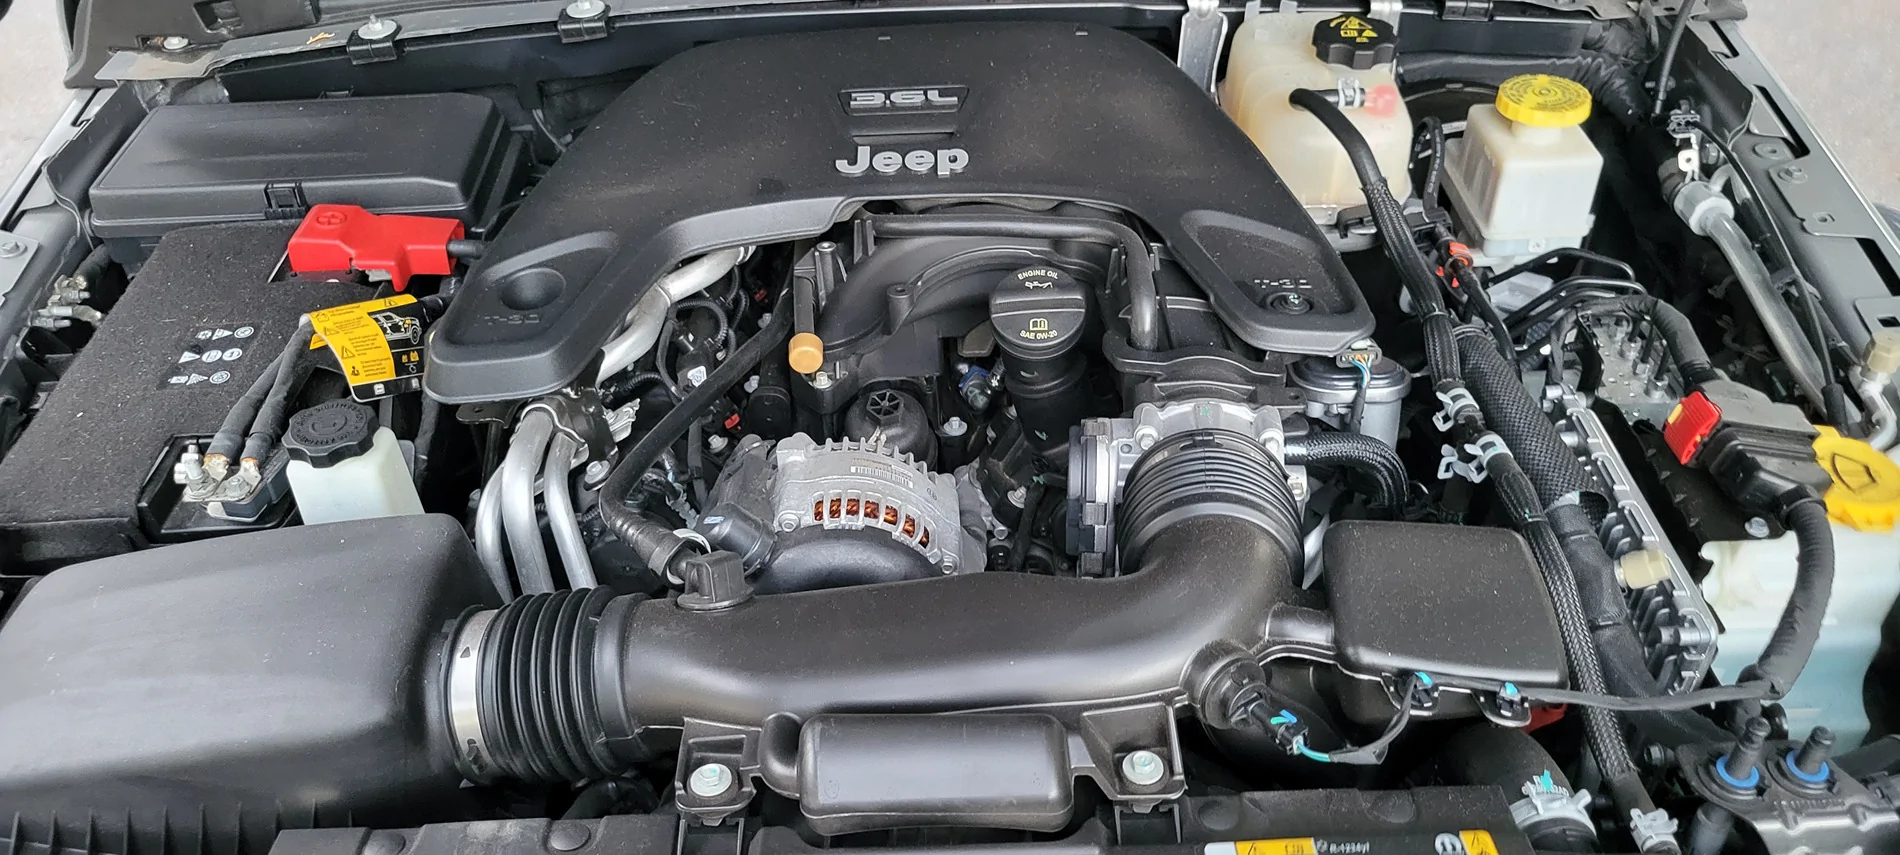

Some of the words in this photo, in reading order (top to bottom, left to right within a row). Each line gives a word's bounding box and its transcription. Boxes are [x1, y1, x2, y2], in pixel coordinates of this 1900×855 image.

[850, 90, 958, 108] 3.6L
[835, 145, 969, 178] Jeep
[1017, 269, 1046, 280] ENGINE
[1046, 270, 1059, 280] OIL
[1019, 330, 1035, 339] SAE
